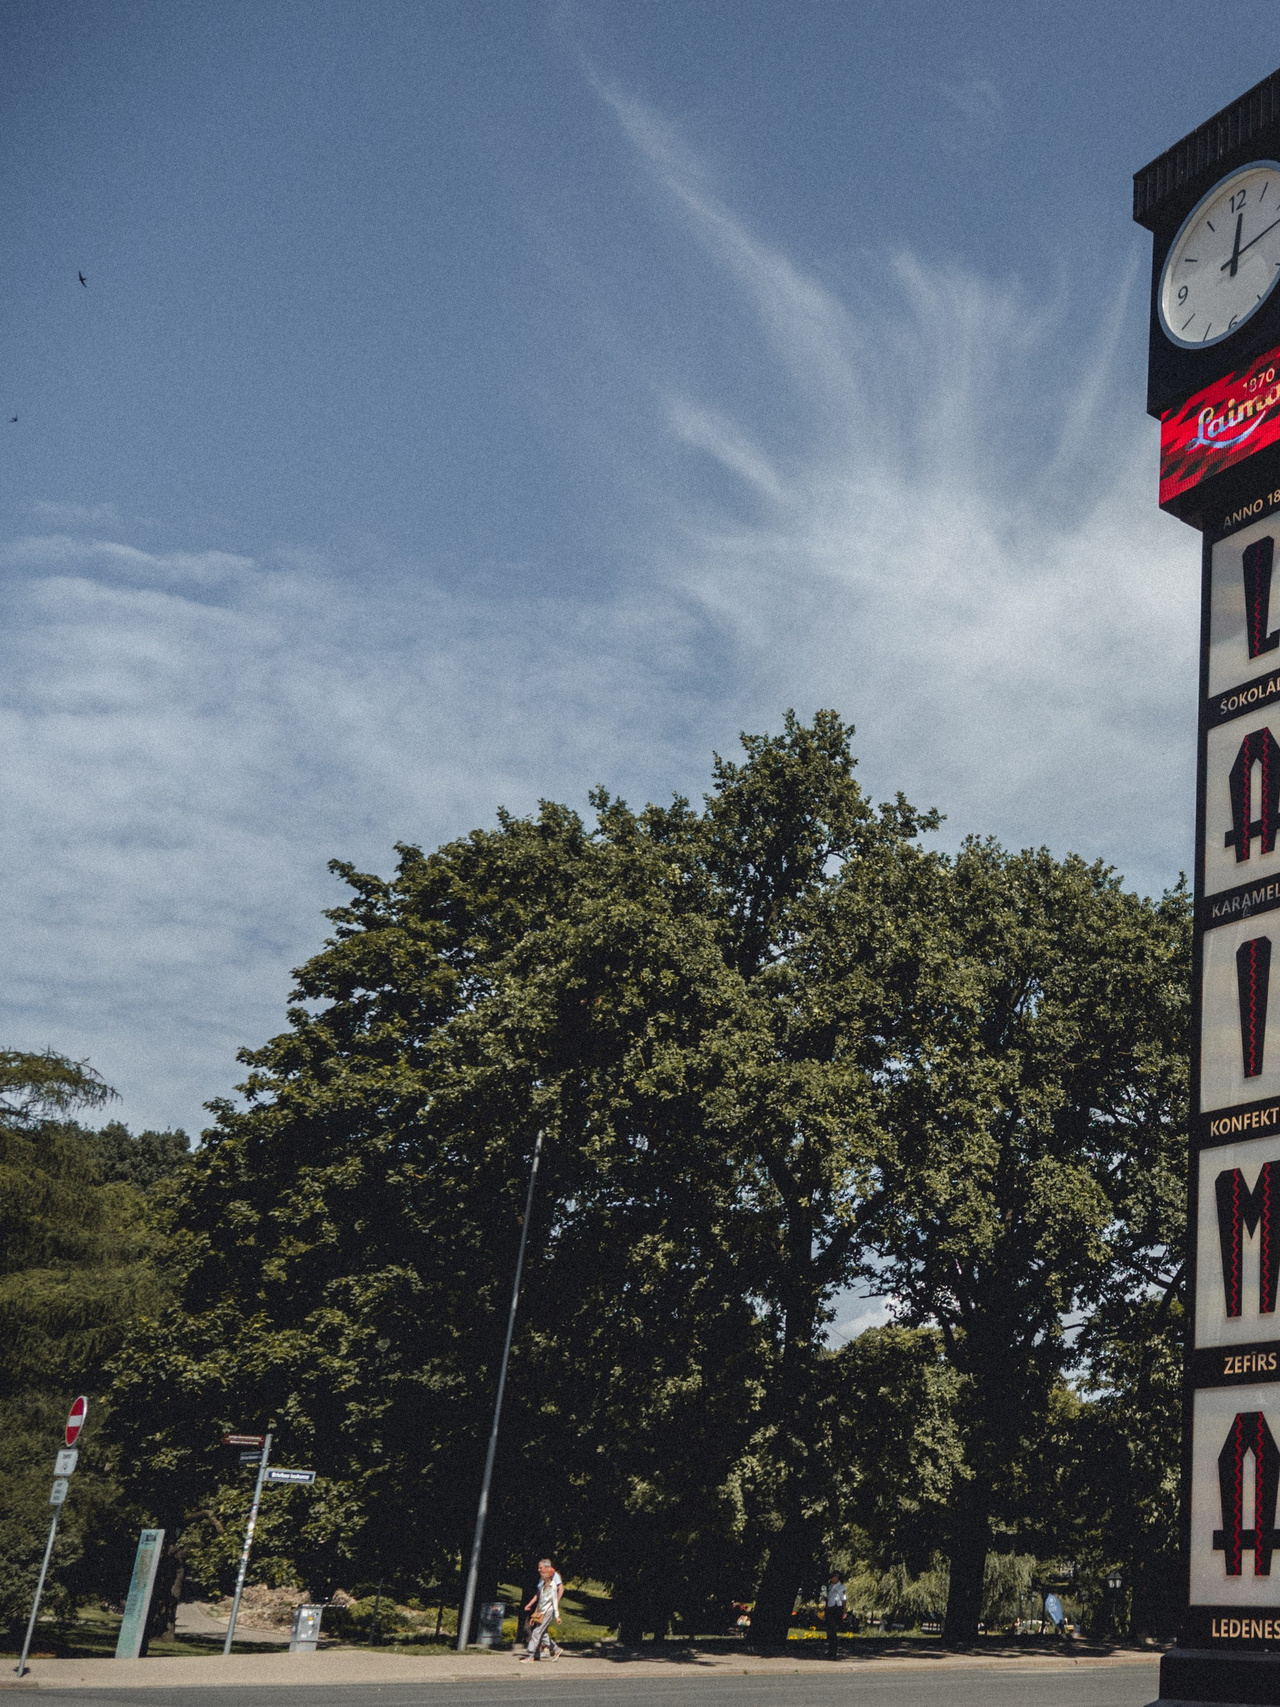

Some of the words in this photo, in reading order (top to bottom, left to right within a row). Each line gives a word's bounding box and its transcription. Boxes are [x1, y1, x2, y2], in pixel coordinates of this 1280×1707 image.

[1229, 189, 1246, 213] 12
[1178, 285, 1189, 306] 9
[1243, 368, 1275, 396] 1870
[1223, 499, 1263, 530] ANNO
[1223, 1351, 1277, 1375] ZEFĪRS
